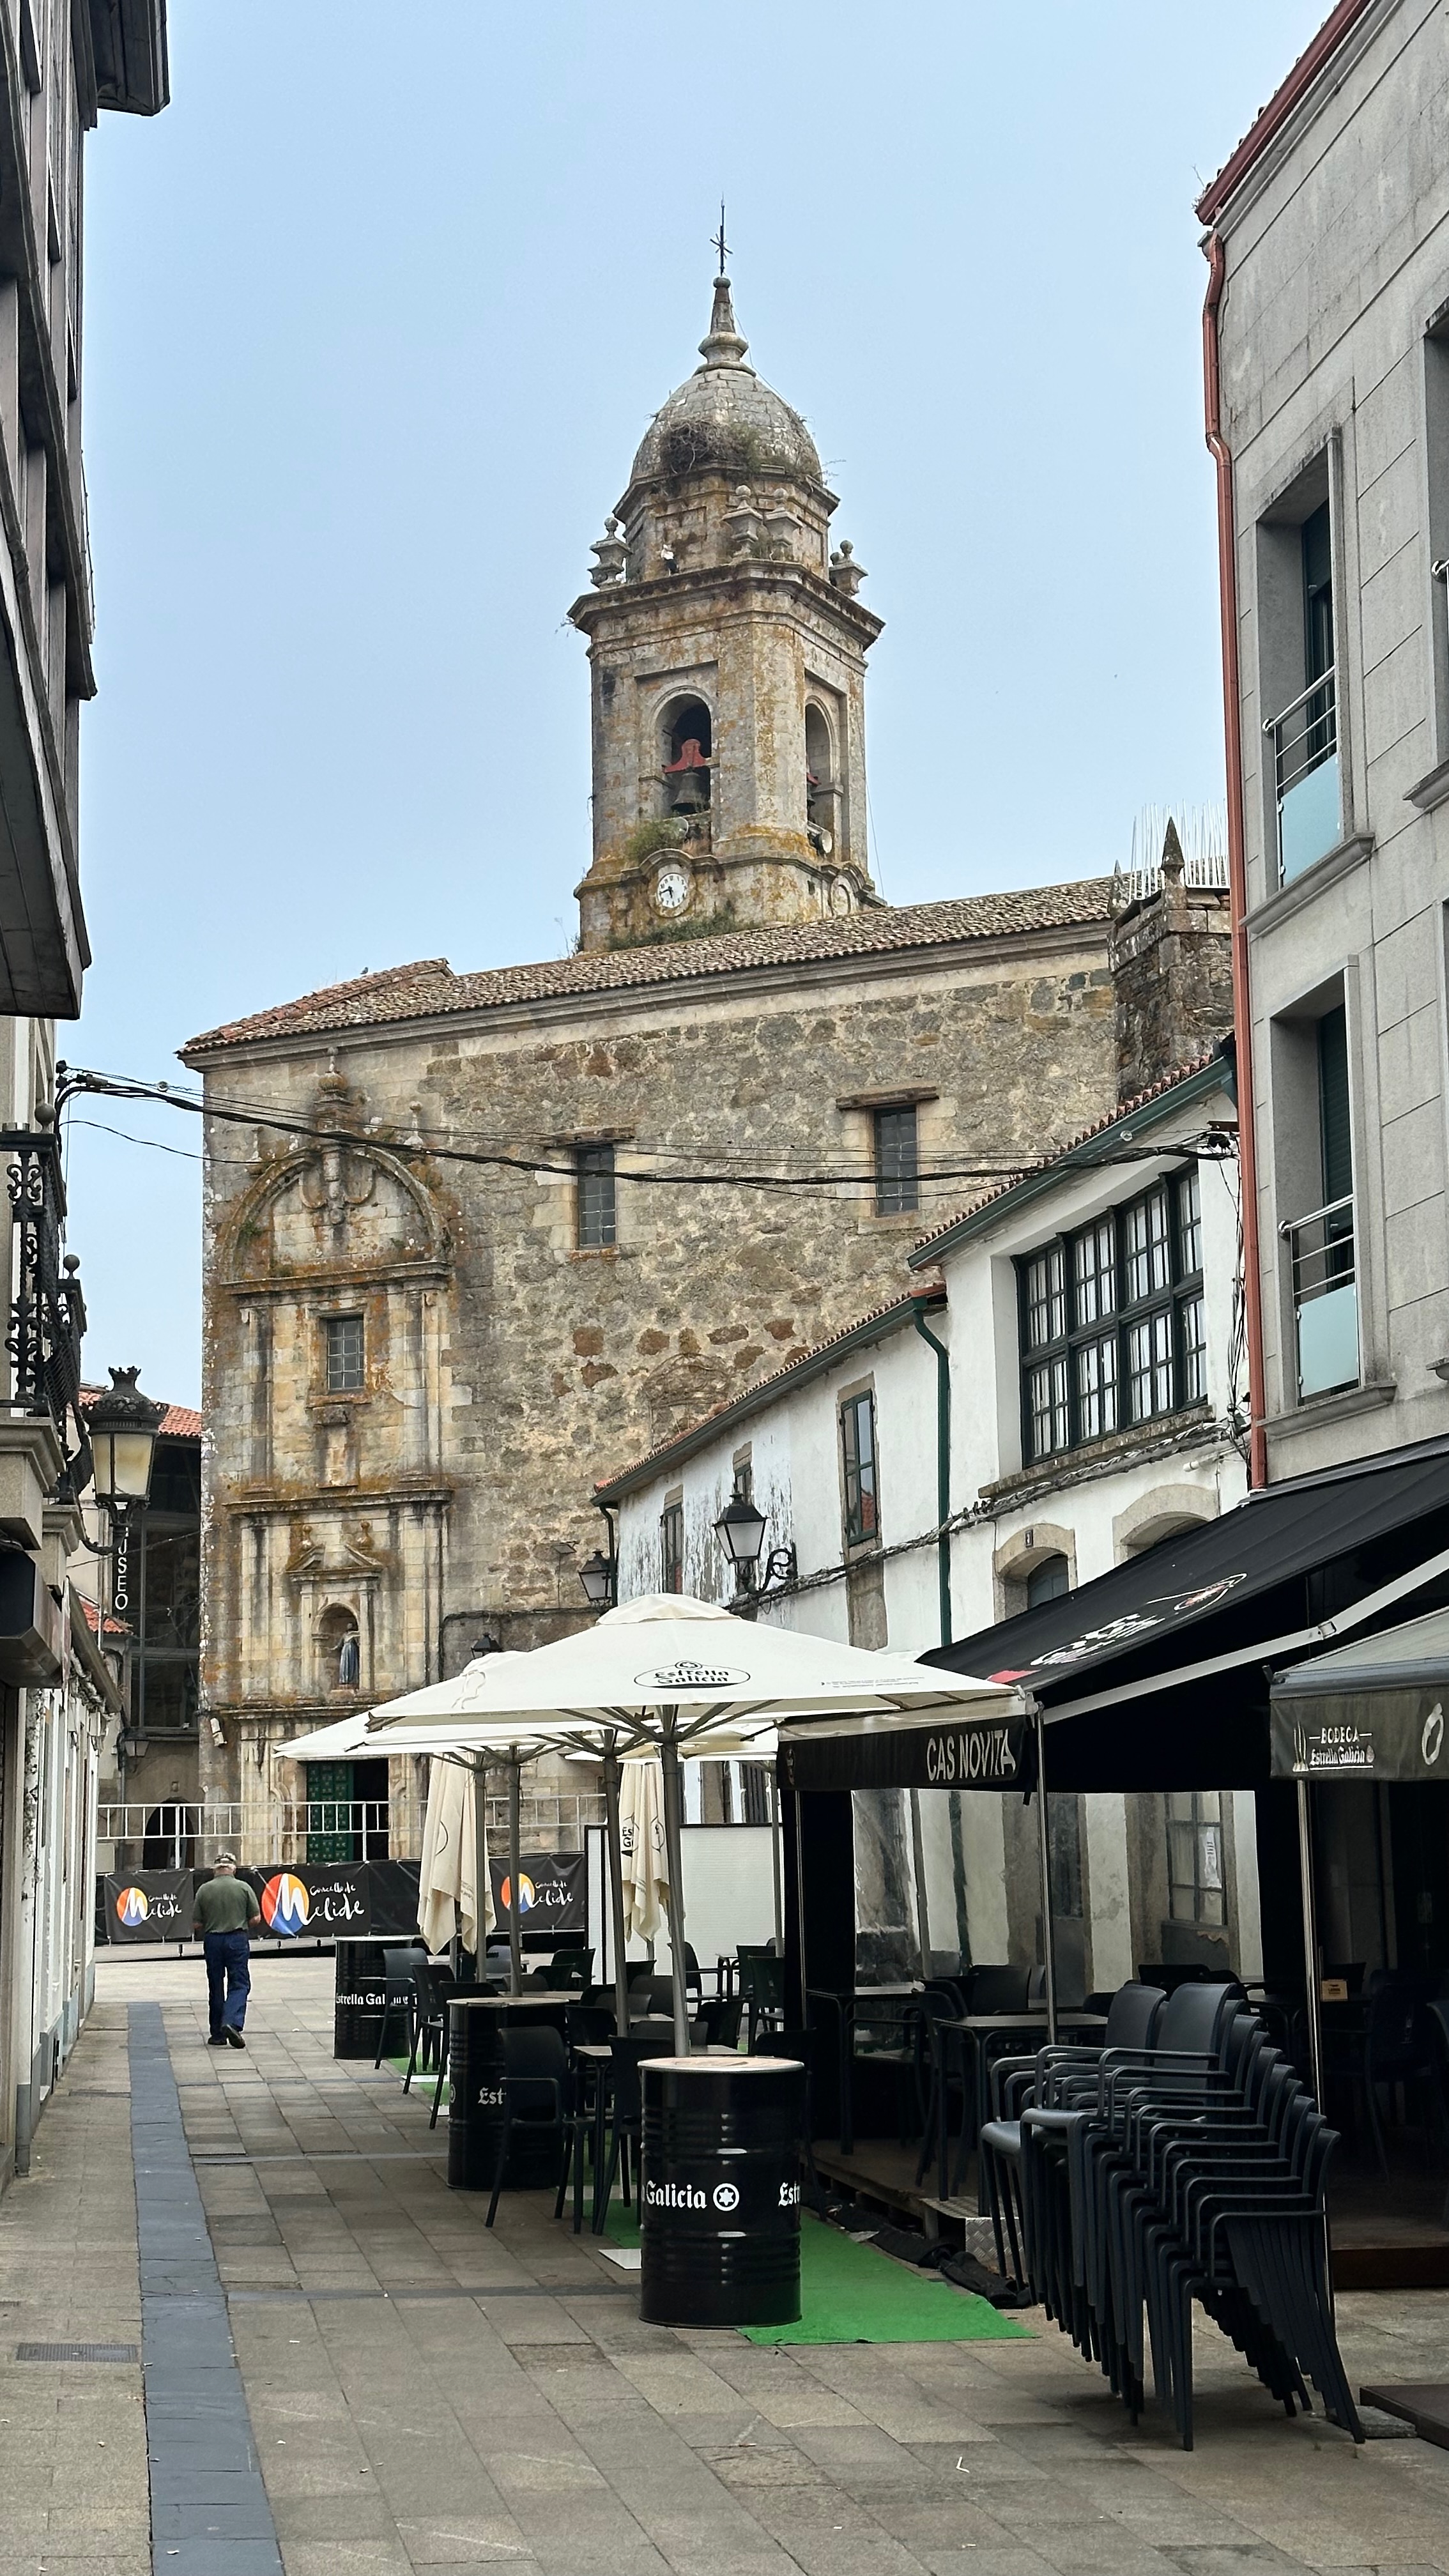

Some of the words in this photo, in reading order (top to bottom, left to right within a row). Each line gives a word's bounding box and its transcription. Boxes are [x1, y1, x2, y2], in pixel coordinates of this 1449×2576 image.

[115, 1527, 128, 1610] USEO
[654, 1669, 729, 1679] Estrella
[657, 1675, 728, 1684] Galicia
[1321, 1726, 1360, 1744] BODEGA
[121, 1887, 183, 1921] Melide
[270, 1873, 365, 1926] Melide
[645, 2180, 708, 2210] Galicia
